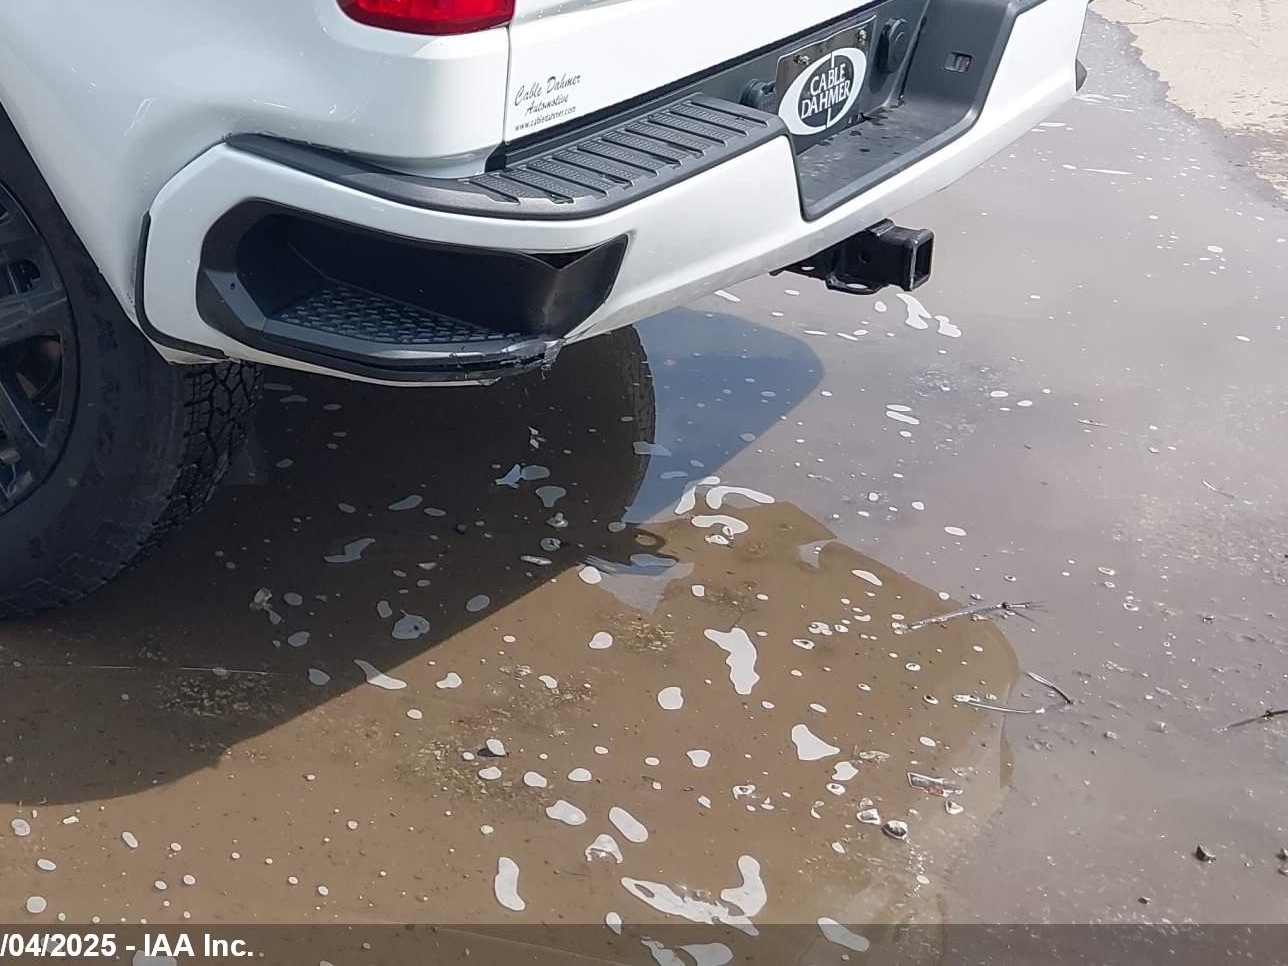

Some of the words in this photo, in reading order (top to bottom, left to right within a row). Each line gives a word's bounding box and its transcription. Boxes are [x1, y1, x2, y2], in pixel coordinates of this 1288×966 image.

[514, 81, 543, 107] Cable
[546, 73, 581, 94] Dahmer
[809, 62, 847, 96] CABLE
[800, 79, 851, 120] DAHMER
